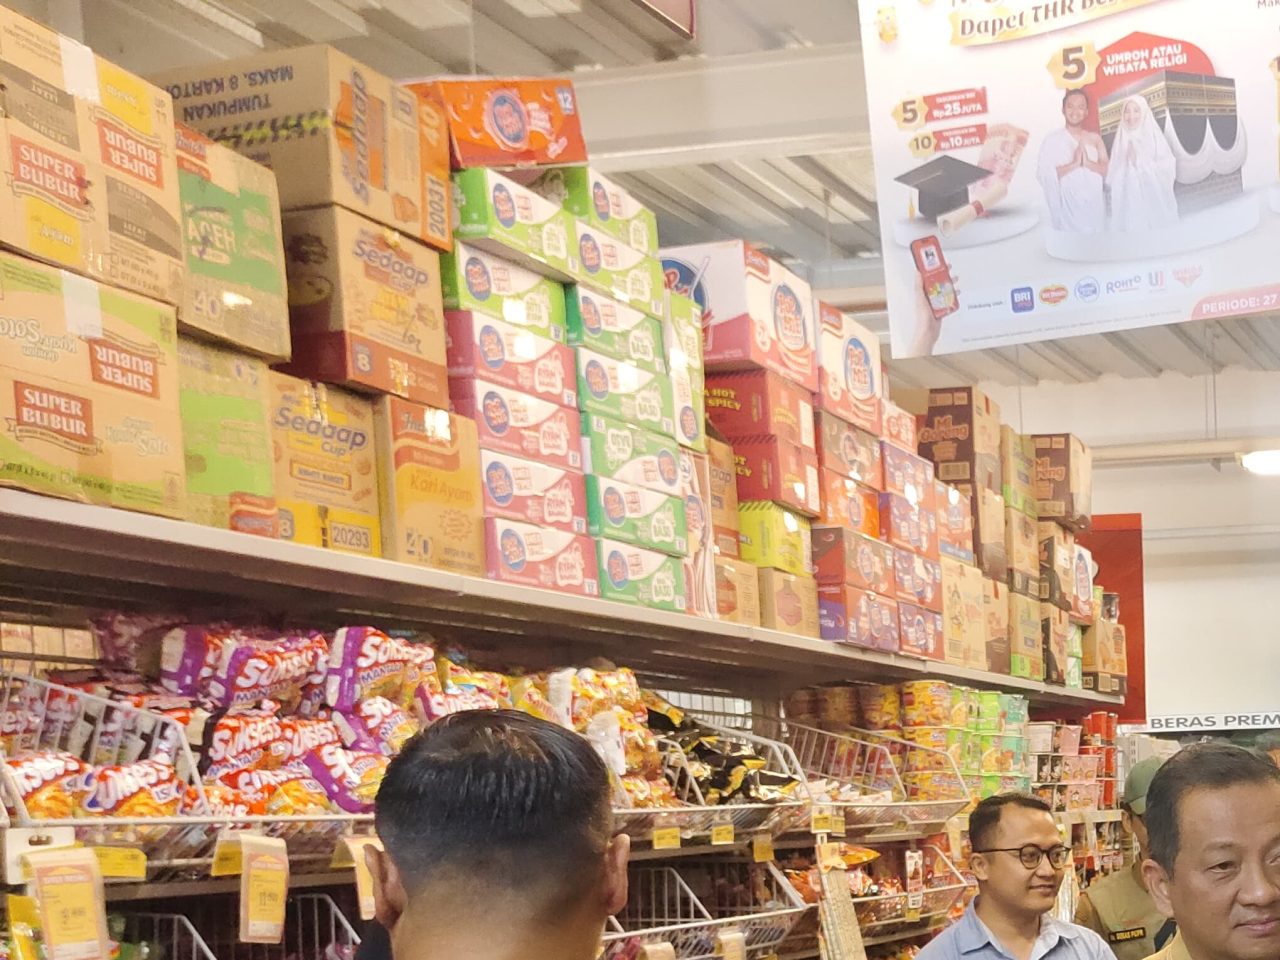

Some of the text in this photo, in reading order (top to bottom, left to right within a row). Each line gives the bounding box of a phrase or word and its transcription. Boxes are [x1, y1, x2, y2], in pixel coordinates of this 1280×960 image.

[960, 0, 1076, 37] Dapet THR
[1062, 46, 1086, 81] 5
[1103, 54, 1187, 76] WISATA RELIGI
[1106, 44, 1182, 65] UMROH ATAU
[166, 65, 294, 101] MAKS. 8 KARTO
[184, 94, 272, 122] TUMPUKAN
[902, 100, 918, 123] 5
[103, 128, 157, 165] BUBUR
[913, 136, 932, 150] 10
[20, 144, 76, 181] SUPER
[109, 148, 157, 182] SUPER
[19, 163, 82, 202] BUBUR
[428, 176, 447, 238] 20031
[353, 239, 428, 289] Sedaap
[1014, 291, 1031, 303] BRI
[1202, 297, 1260, 314] PERIODE:
[1263, 294, 1278, 305] 27
[95, 345, 153, 376] BUBUR
[100, 365, 153, 393] SUPER
[24, 388, 82, 416] SUPER
[712, 388, 736, 399] HOT
[22, 407, 87, 437] BUBUR
[410, 475, 474, 503] Kari Ayam
[332, 526, 370, 549] 20293
[1151, 716, 1217, 729] BERAS
